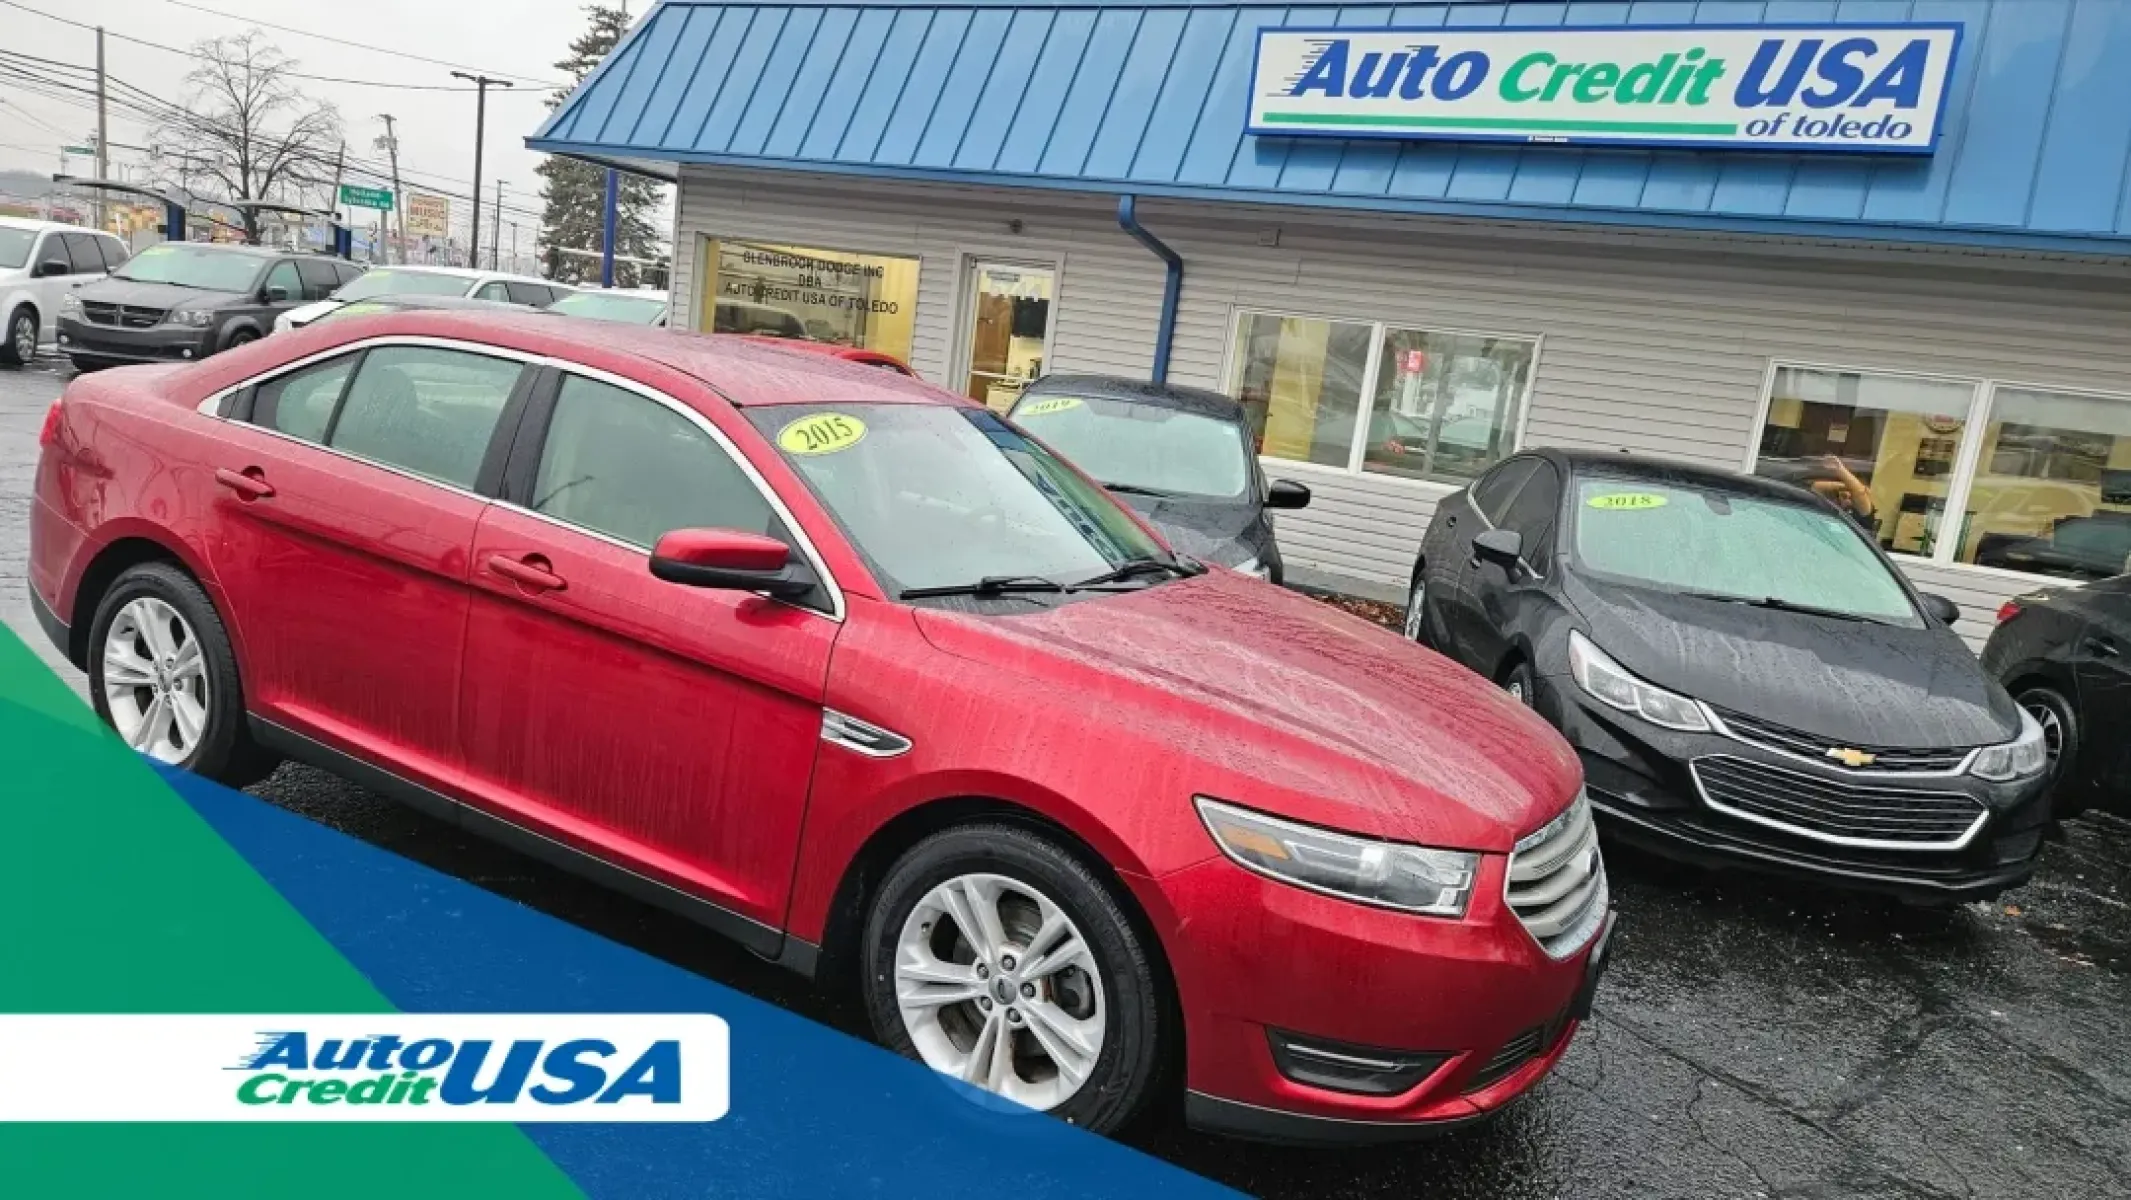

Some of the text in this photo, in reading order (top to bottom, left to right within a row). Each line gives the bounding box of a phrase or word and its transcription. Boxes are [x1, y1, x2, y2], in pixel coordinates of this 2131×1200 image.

[1280, 38, 1932, 109] Auto Credit USA
[1745, 113, 1914, 139] of toledo
[798, 273, 822, 288] DBA
[816, 259, 861, 276] DODGE
[863, 264, 884, 279] INC
[802, 292, 826, 306] USA
[828, 294, 845, 308] OF
[848, 296, 898, 315] TOLEDO
[795, 417, 853, 450] 2015
[1604, 495, 1652, 507] 2018
